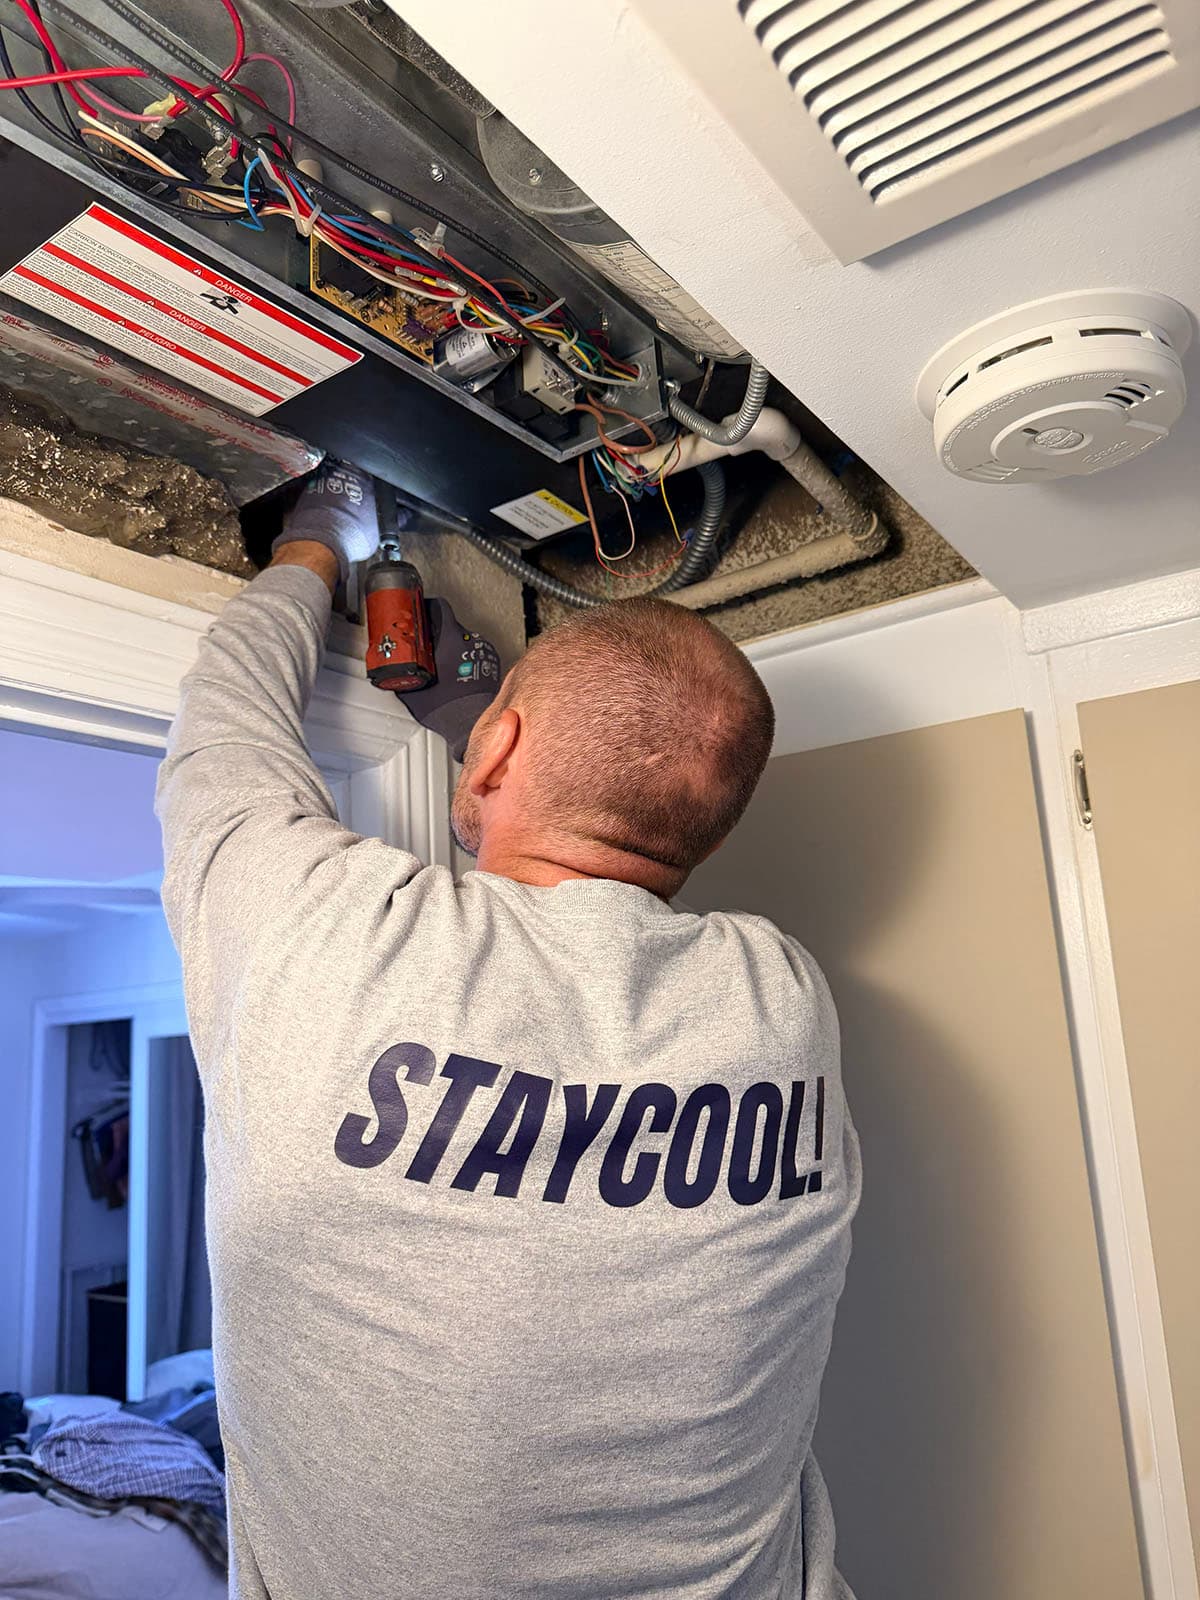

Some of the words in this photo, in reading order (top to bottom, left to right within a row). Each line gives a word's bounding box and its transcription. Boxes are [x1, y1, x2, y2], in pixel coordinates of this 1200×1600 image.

[189, 60, 203, 72] CU
[197, 108, 211, 119] AND
[38, 249, 65, 266] RISQUE
[66, 226, 98, 247] CARBON
[97, 243, 134, 266] MONOXIDE
[132, 262, 168, 285] POISONING
[166, 282, 195, 300] HAZARD
[10, 272, 38, 289] RIESGO
[37, 286, 48, 294] DE
[215, 280, 253, 303] DANGER
[169, 309, 207, 332] DANGER
[138, 328, 177, 350] PELIGRO
[334, 1041, 826, 1209] STAYCOOL!
